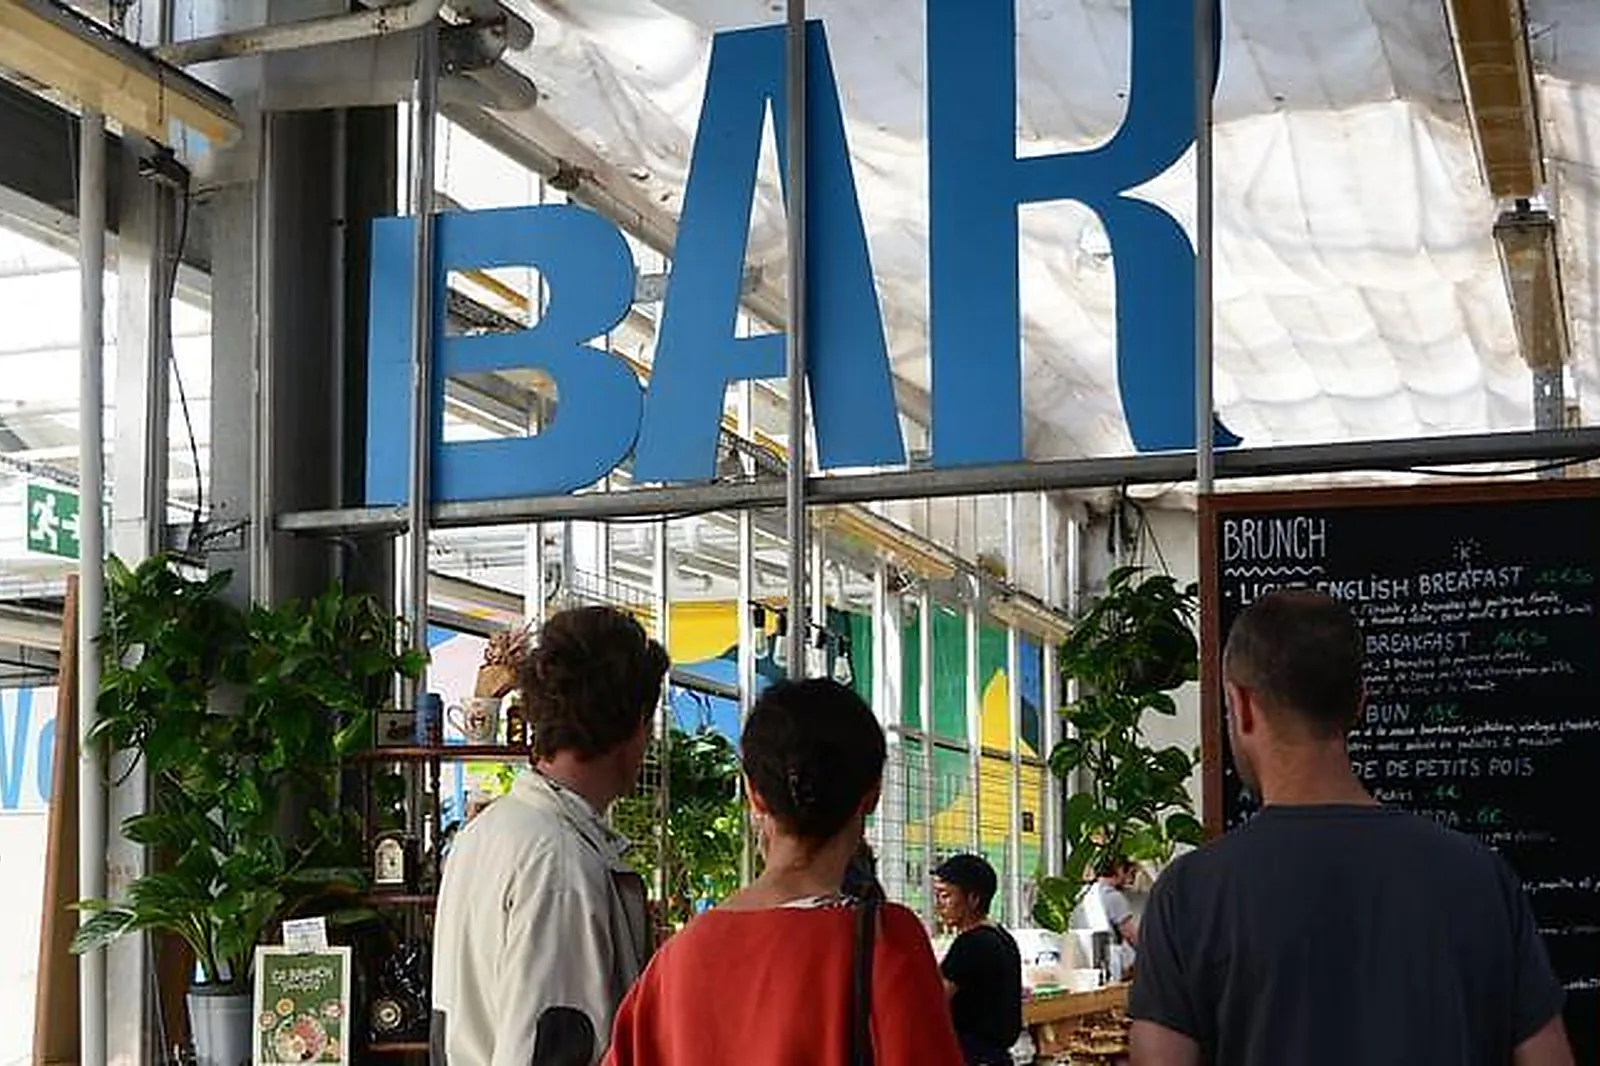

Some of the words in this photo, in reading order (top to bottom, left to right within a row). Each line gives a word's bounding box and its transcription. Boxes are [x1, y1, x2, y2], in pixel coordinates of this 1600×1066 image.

[366, 0, 1241, 505] BAR
[1224, 516, 1326, 560] BRUNCH
[1365, 631, 1471, 654] BREAKFAST
[1365, 703, 1410, 724] BUN
[1386, 757, 1410, 779] DE
[1415, 756, 1481, 778] PETITS
[1488, 756, 1535, 778] POIS
